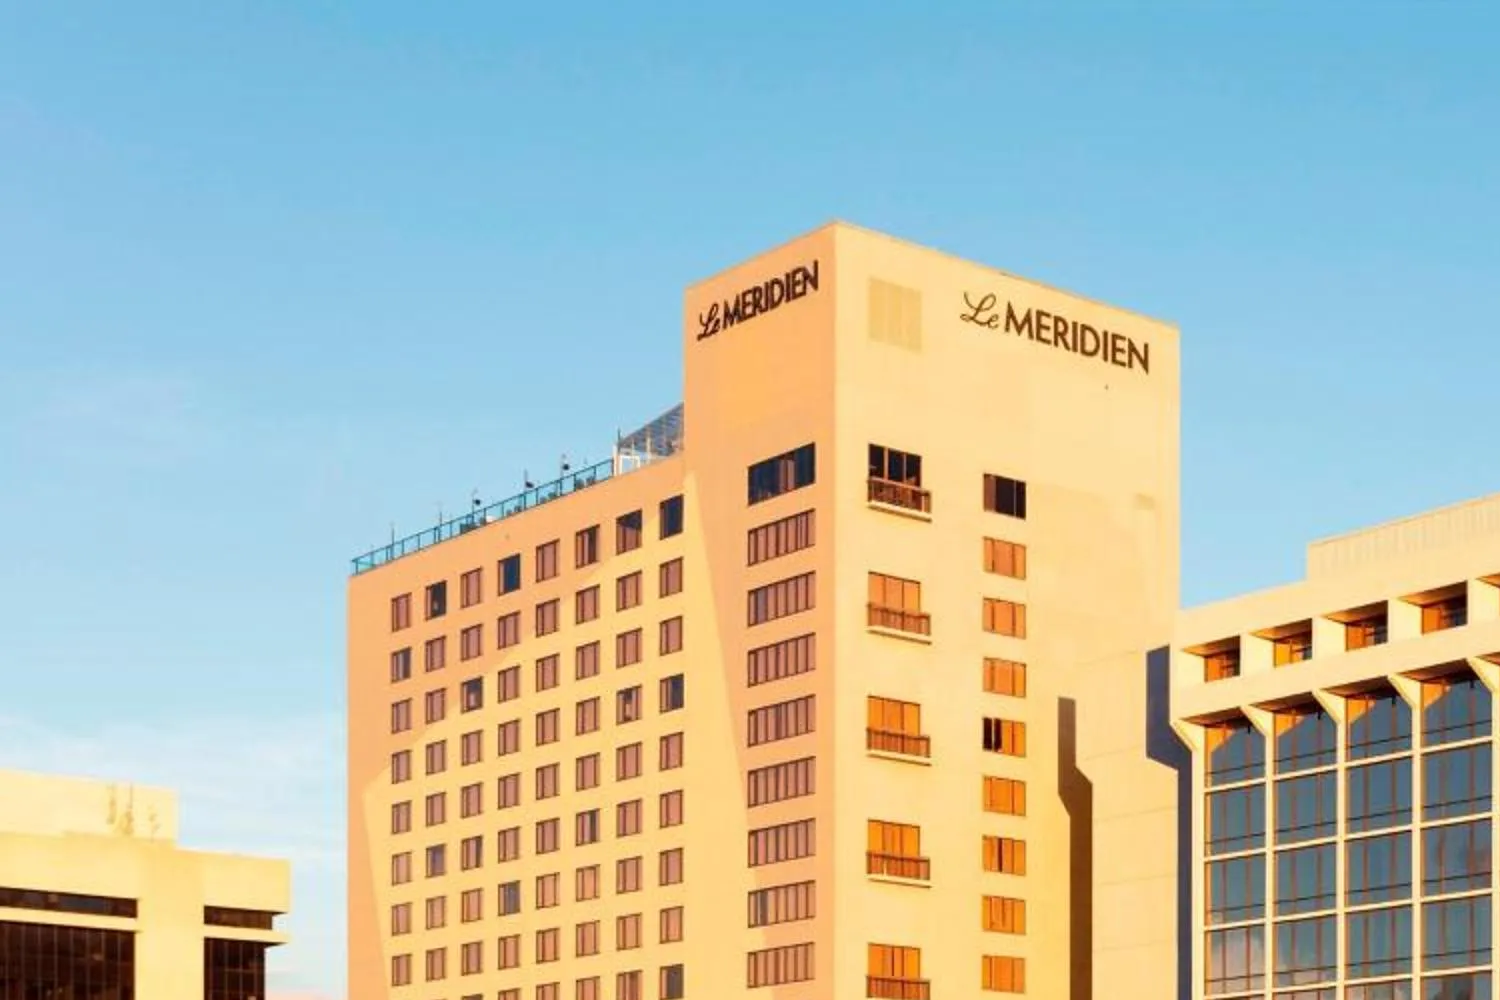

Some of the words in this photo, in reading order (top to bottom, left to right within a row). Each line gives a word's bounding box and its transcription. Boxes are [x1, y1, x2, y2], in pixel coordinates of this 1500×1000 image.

[697, 303, 720, 341] Le
[723, 259, 819, 330] MERIDIEN
[960, 292, 1000, 330] Le
[1004, 300, 1149, 375] MERIDIEN
